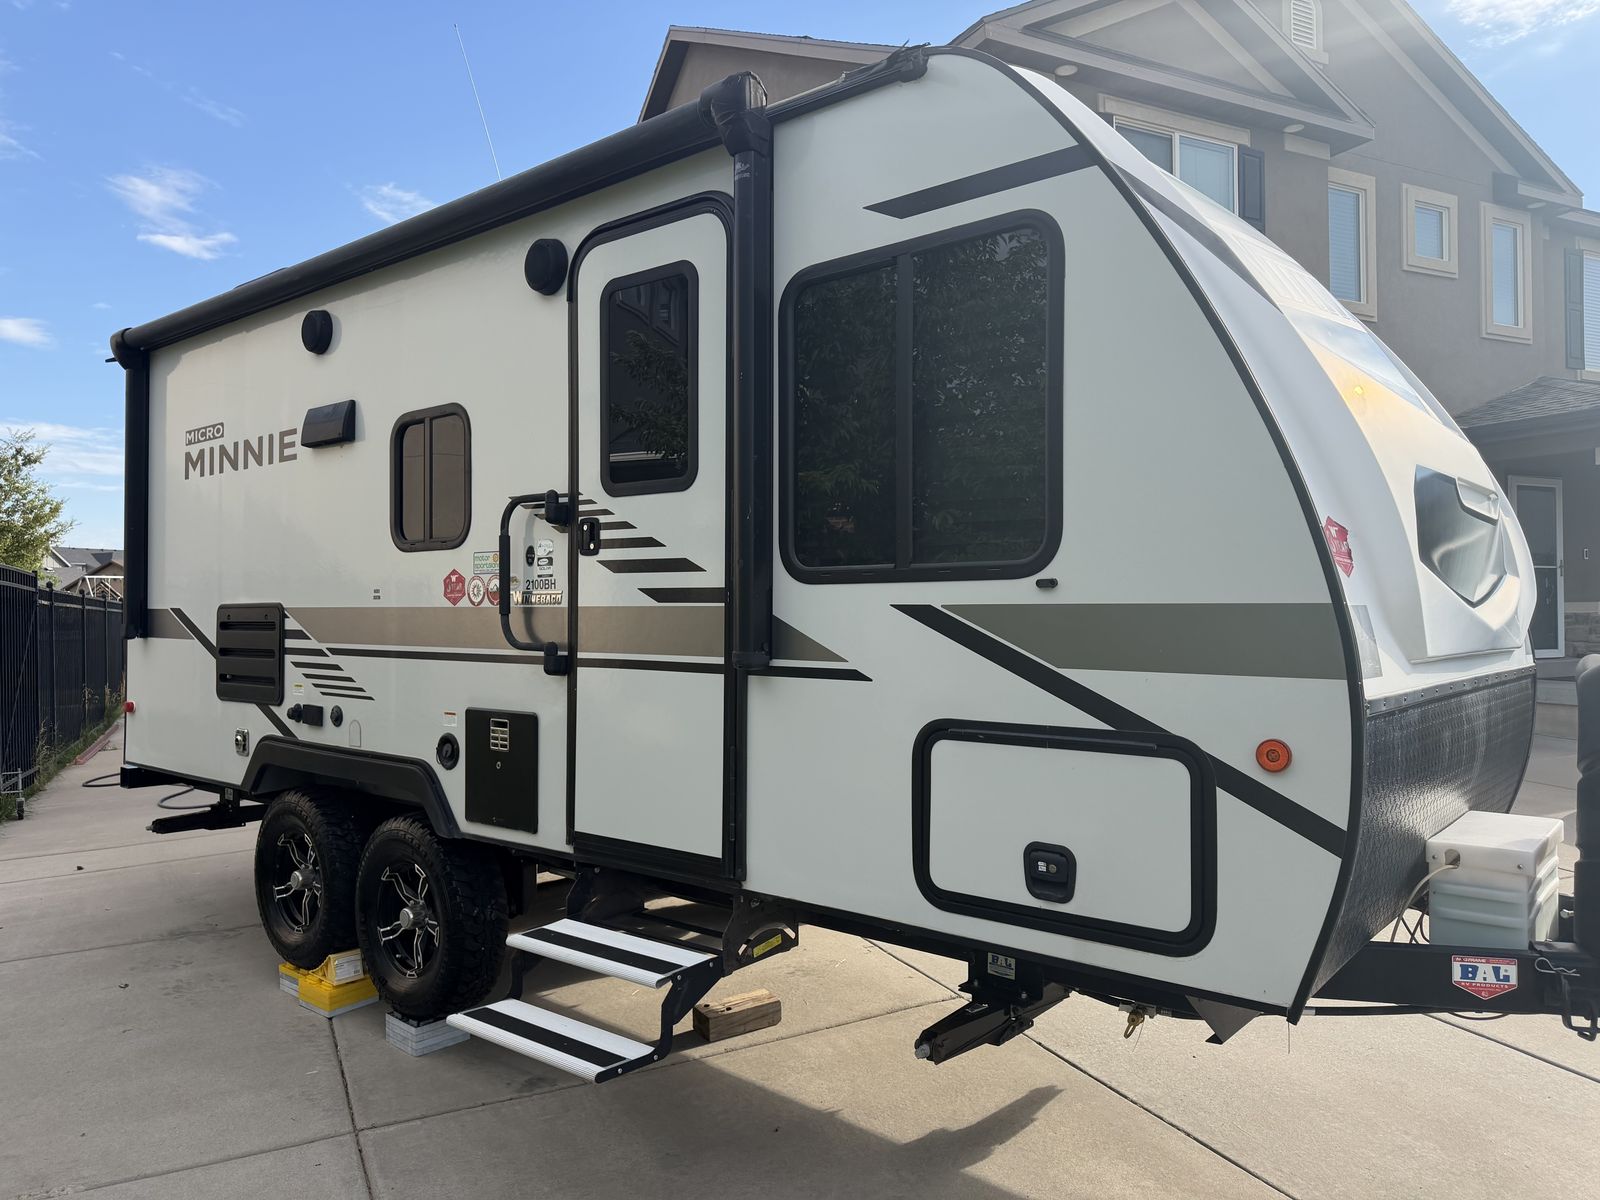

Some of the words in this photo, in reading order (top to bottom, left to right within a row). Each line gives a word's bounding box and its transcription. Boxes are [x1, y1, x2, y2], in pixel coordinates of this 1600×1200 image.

[186, 424, 223, 445] MICRO
[184, 428, 298, 480] MINNIE
[526, 579, 556, 590] 2100BH
[511, 590, 563, 605] WINNEBAGO
[1460, 964, 1510, 982] BAL
